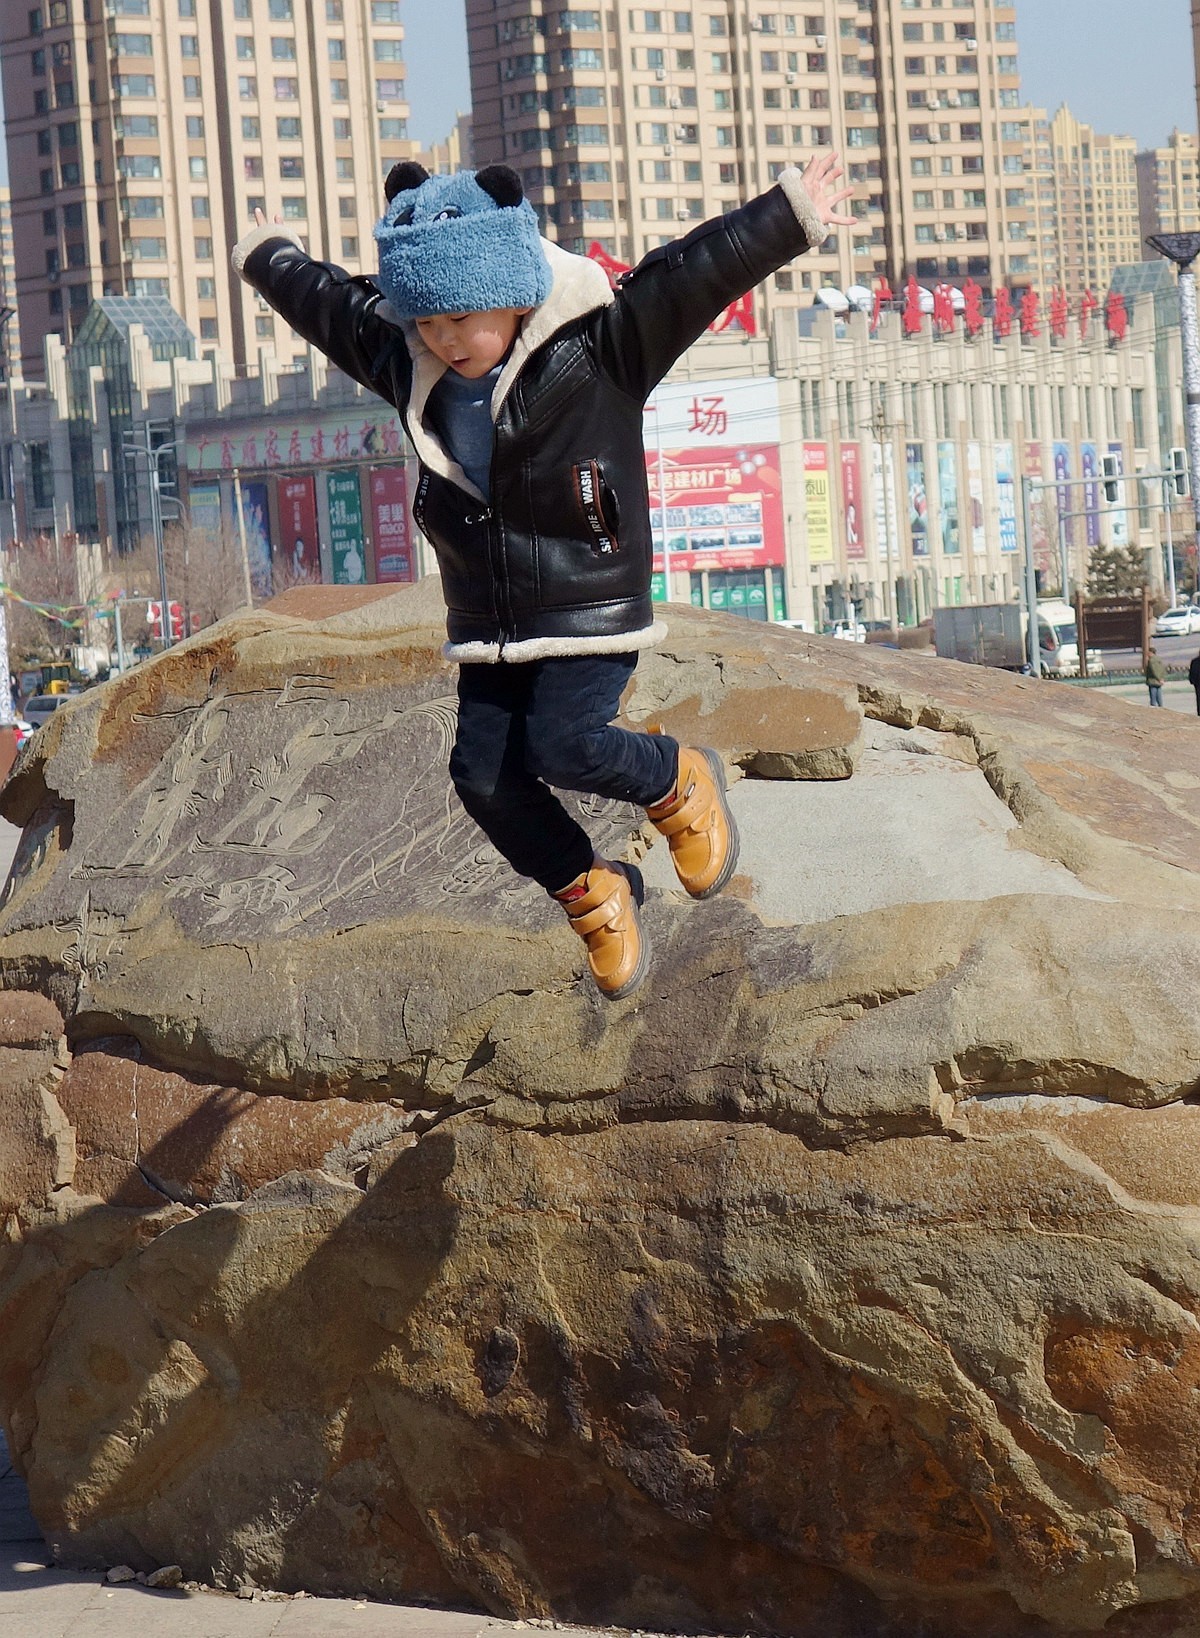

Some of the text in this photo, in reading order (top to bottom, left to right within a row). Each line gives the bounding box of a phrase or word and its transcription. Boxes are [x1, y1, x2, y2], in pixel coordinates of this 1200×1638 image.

[687, 396, 728, 436] 场
[419, 474, 430, 496] IRIE
[580, 470, 594, 504] WASH
[805, 478, 826, 496] 泰山
[588, 515, 603, 532] IRIE
